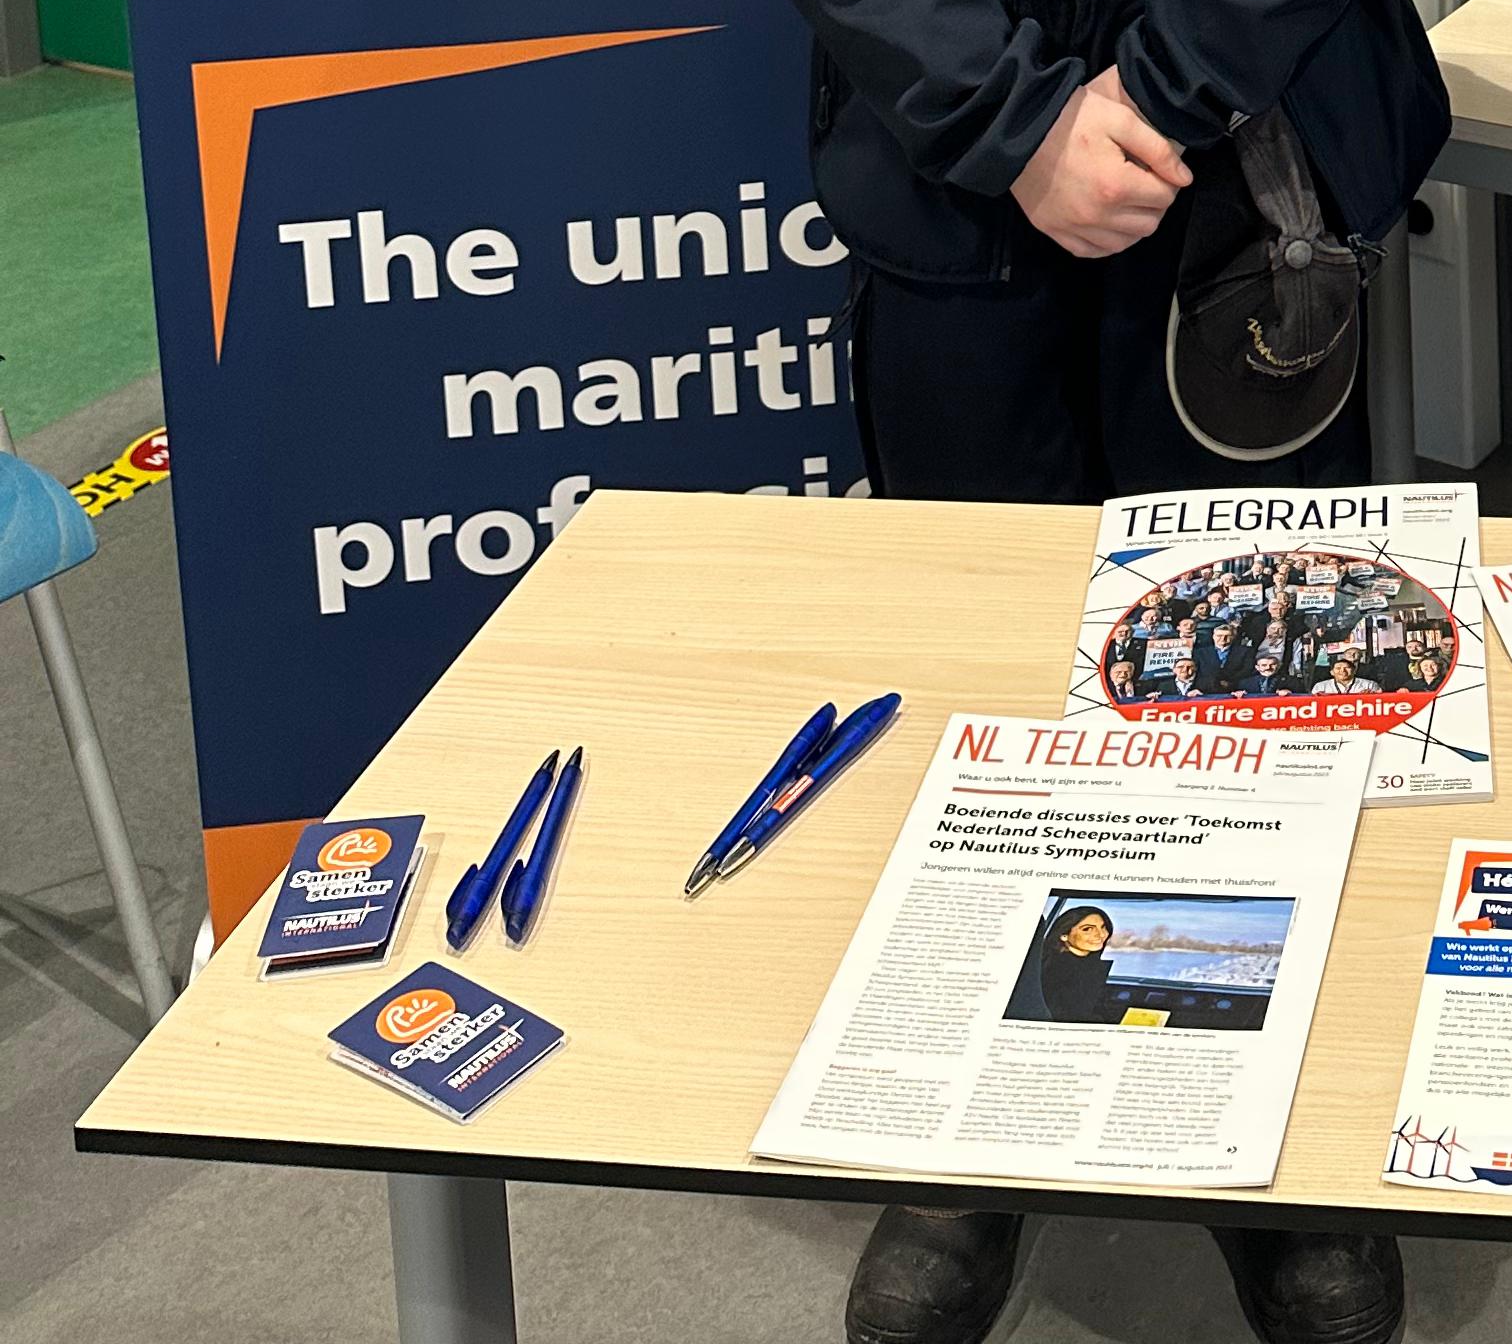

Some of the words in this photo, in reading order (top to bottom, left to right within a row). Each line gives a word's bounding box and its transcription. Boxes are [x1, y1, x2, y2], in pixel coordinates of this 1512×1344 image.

[278, 210, 519, 309] The
[442, 317, 855, 440] mariti
[1121, 496, 1388, 537] TELEGRAPH
[1141, 707, 1197, 726] End
[1204, 703, 1253, 724] fire
[1262, 701, 1318, 721] and
[1325, 698, 1412, 718] rehire
[952, 724, 1004, 763] NL
[1024, 728, 1267, 775] TELEGRAPH
[1376, 774, 1404, 790] 30
[944, 803, 1032, 822] Boeiende
[1036, 809, 1131, 826] discussies
[1138, 815, 1179, 827] over
[937, 820, 1038, 840] Nederland
[929, 838, 956, 853] op
[959, 840, 1039, 857] Nautilus
[1043, 844, 1156, 864] Symposium
[294, 869, 367, 886] Samen
[309, 882, 389, 900] sterker
[284, 914, 361, 932] NAUTILUS
